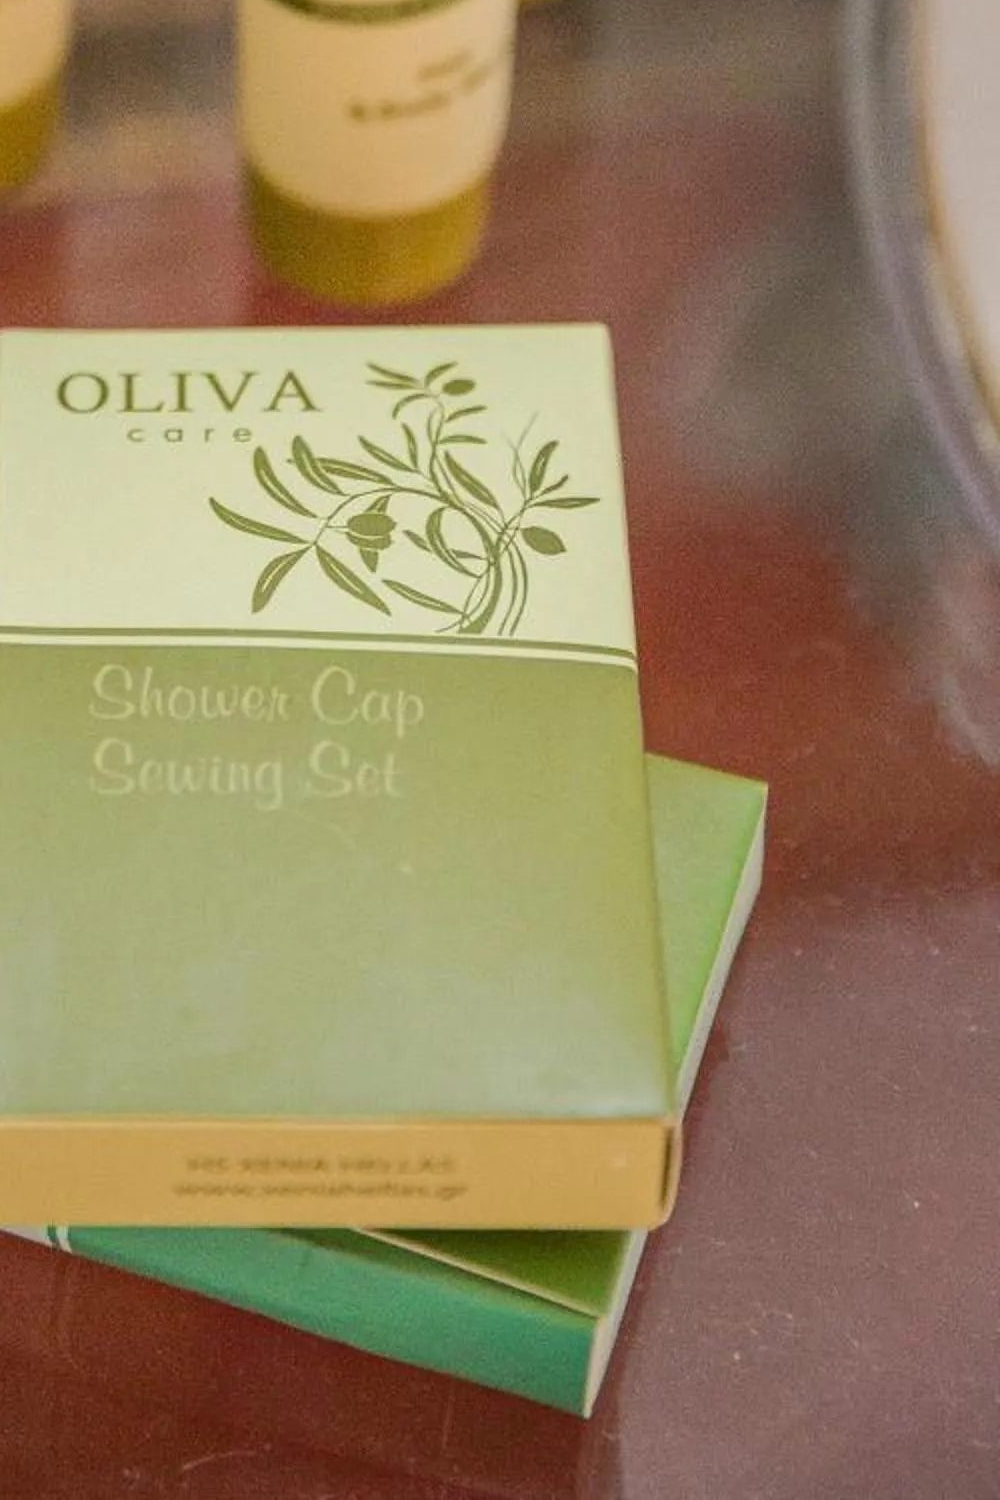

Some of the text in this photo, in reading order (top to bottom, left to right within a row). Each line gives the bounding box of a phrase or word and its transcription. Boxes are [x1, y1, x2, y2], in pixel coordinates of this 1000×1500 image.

[57, 370, 322, 414] OLIVA
[126, 427, 253, 443] care
[89, 663, 425, 738] Shower Cap
[89, 737, 403, 812] Sewing Set
